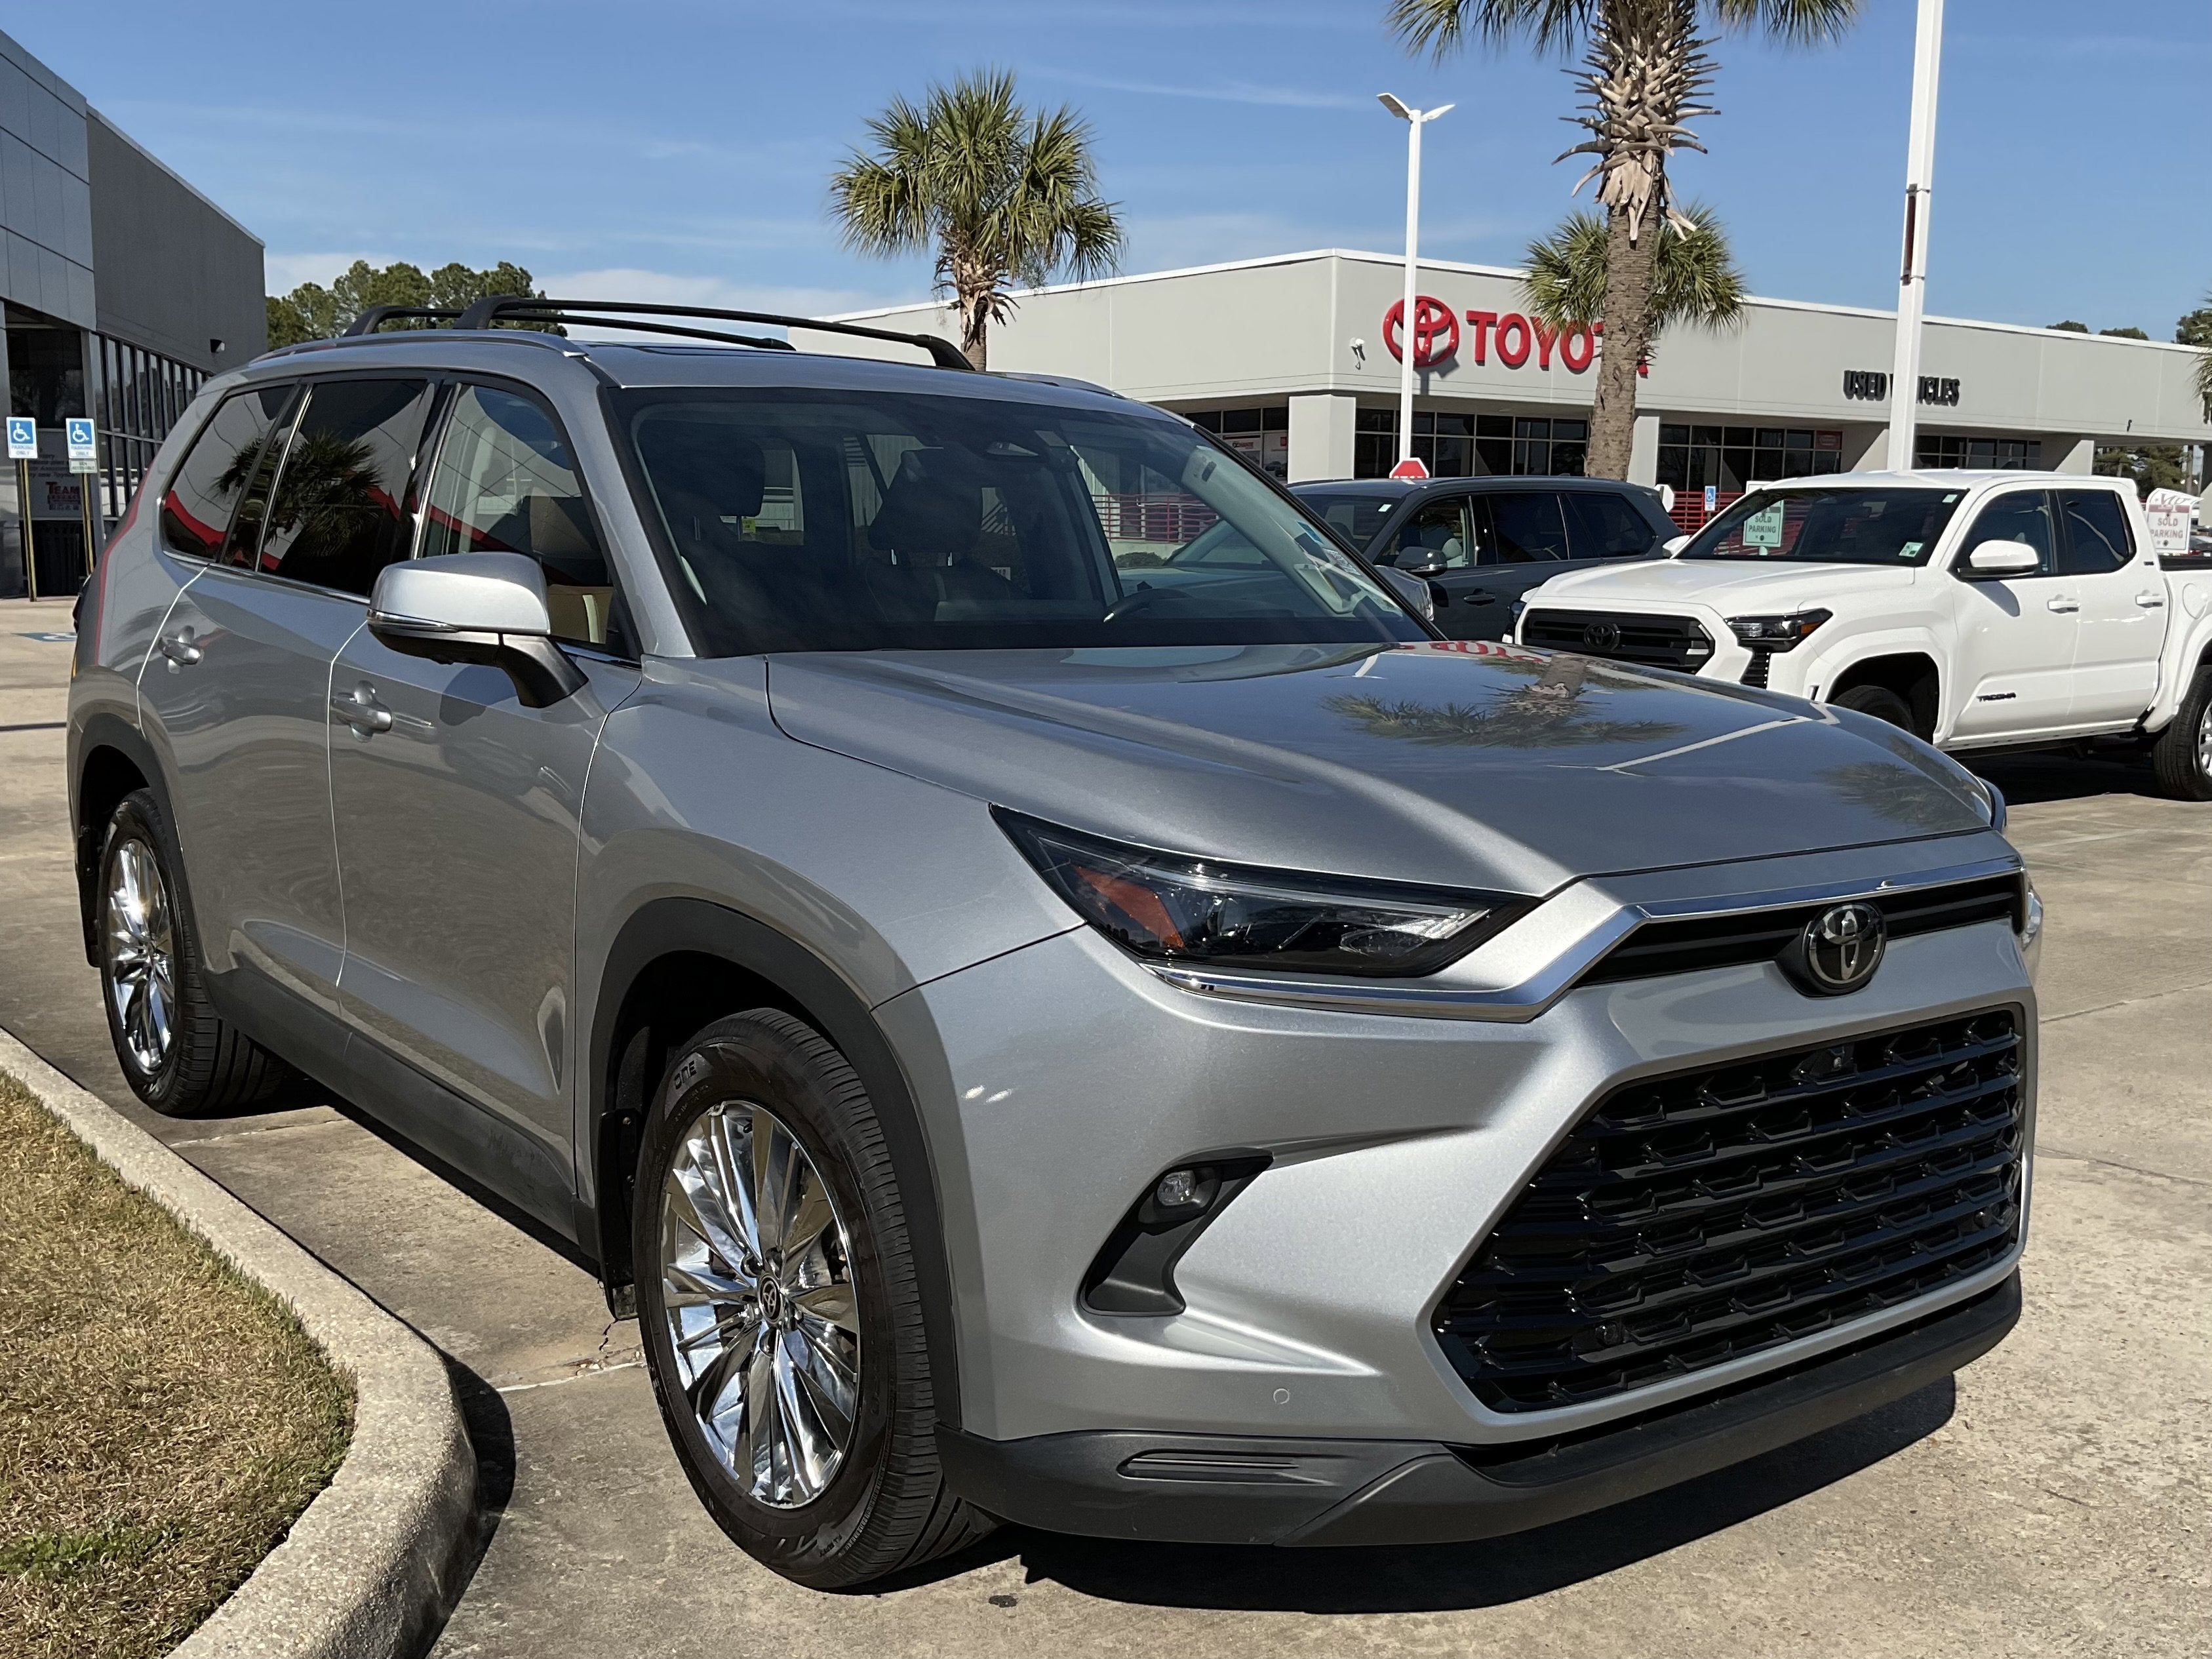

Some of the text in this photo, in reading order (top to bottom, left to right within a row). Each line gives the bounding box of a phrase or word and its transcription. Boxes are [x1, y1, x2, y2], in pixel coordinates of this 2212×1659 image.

[1466, 310, 1648, 375] TOYO
[1844, 370, 1960, 406] USED ICLES
[2150, 529, 2183, 538] PARKING
